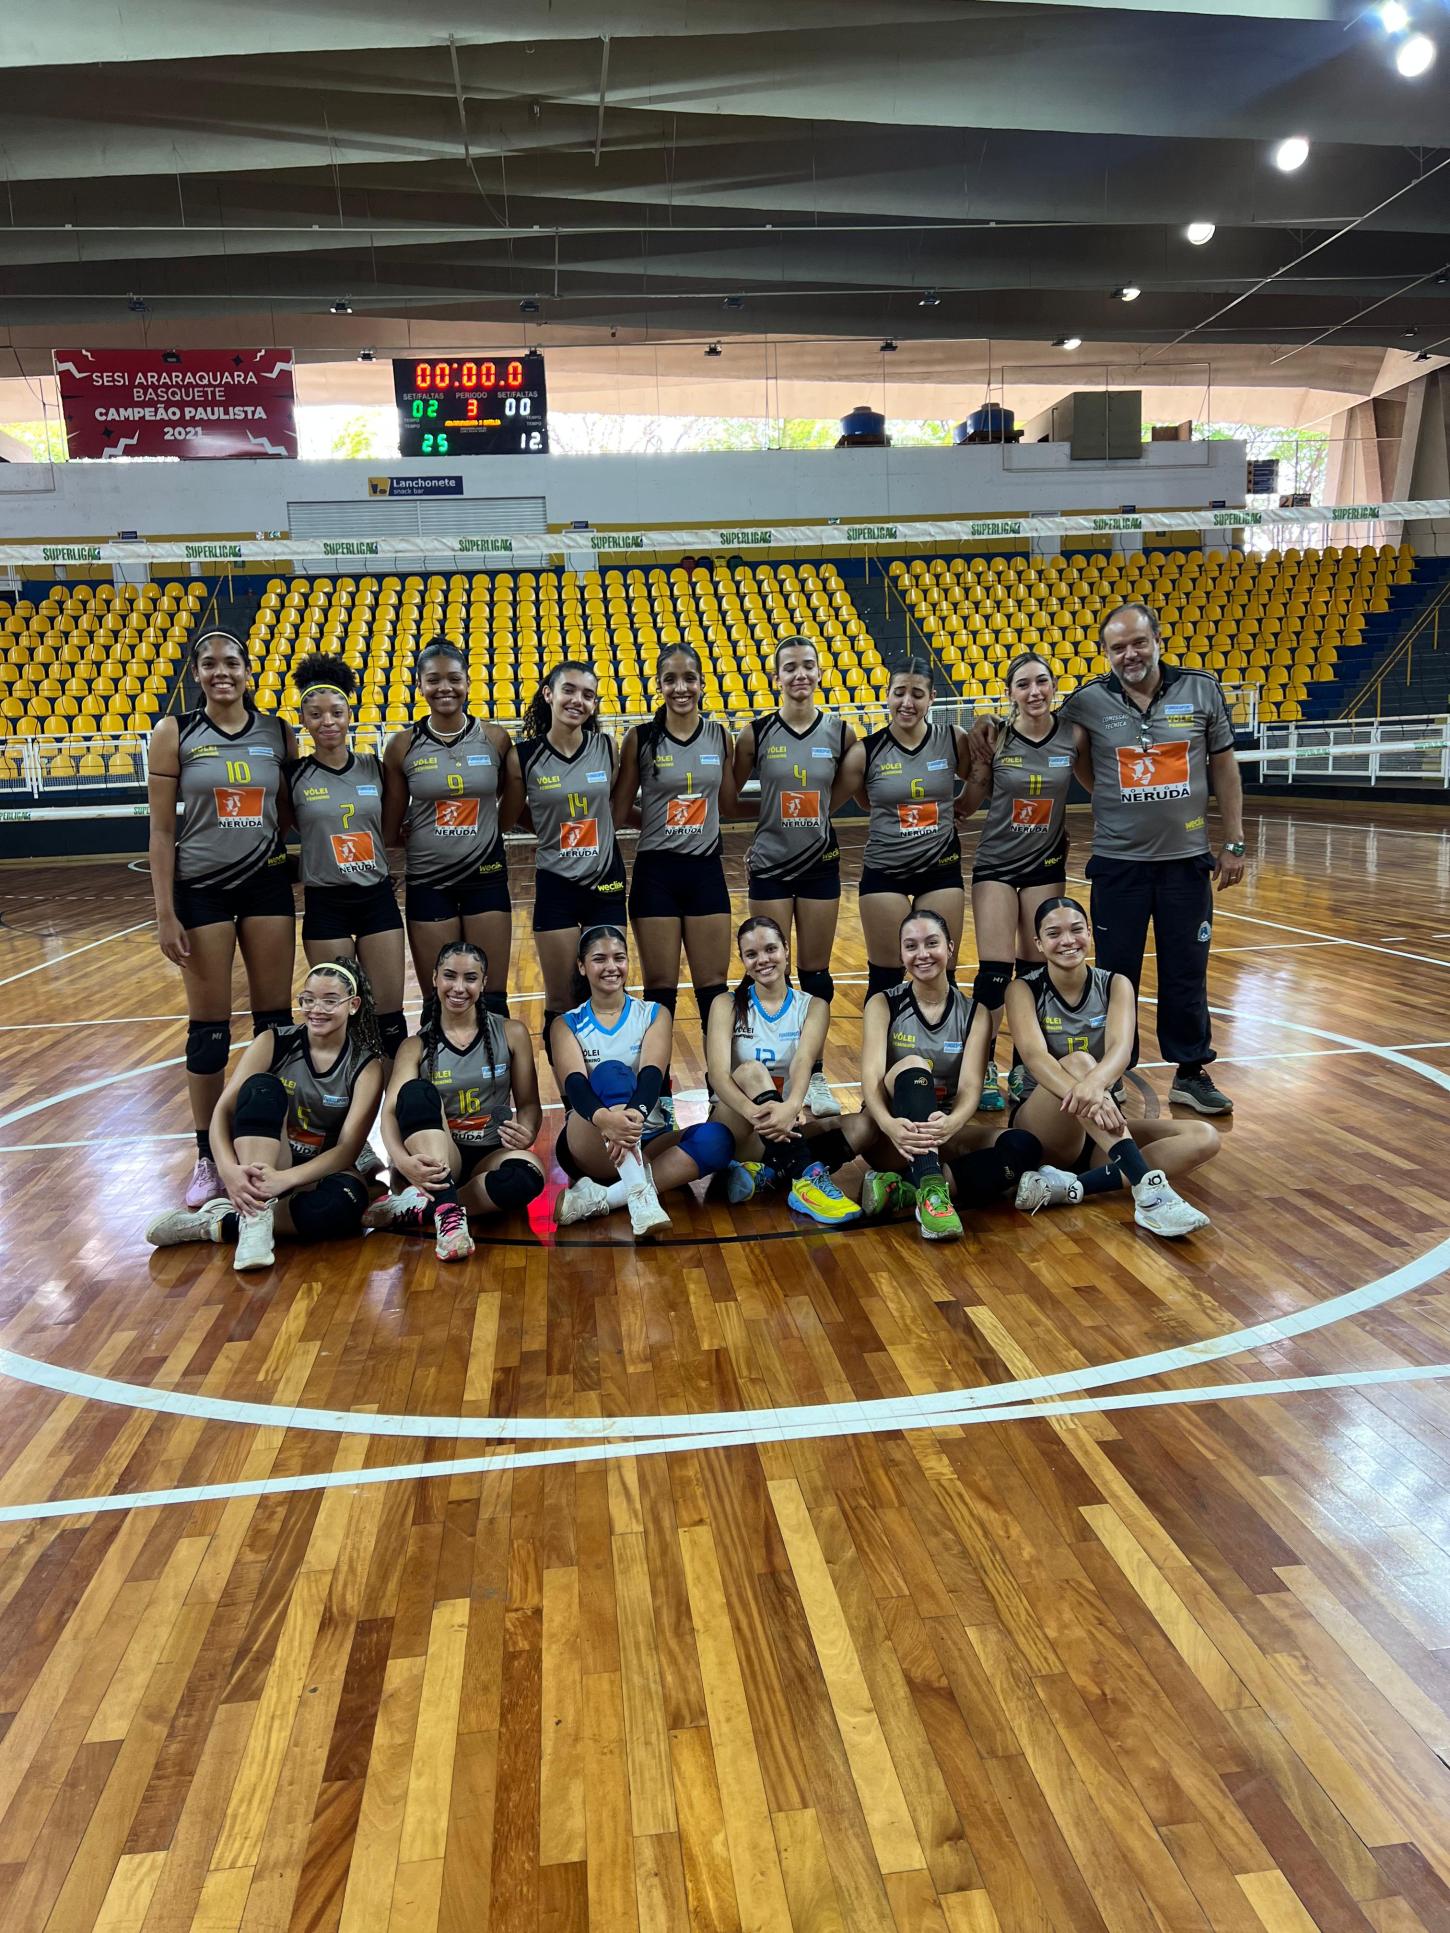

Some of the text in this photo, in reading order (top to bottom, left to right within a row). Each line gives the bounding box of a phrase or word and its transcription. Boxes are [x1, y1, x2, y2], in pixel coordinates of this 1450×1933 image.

[92, 371, 258, 386] SESI ARARAQUARA
[133, 387, 226, 401] BASQUETE
[94, 403, 267, 421] CAMPEÃO PAULISTA
[412, 399, 439, 418] 02
[467, 398, 478, 416] 3
[504, 397, 531, 416] 00
[163, 426, 203, 441] 2021
[421, 433, 449, 453] 25
[393, 478, 456, 488] Lanchonete
[1213, 513, 1258, 526] SUPERLIGA
[1331, 506, 1376, 520] SUPERLIGA
[846, 526, 892, 540] SUPERLIGA
[970, 522, 1015, 536] SUPERLIGA
[590, 535, 639, 549] SUPERLIGA
[719, 531, 767, 545] SUPERLIGA
[185, 544, 234, 559] SUPERLIGA
[323, 541, 372, 556] SUPERLIGA
[458, 538, 507, 553] SUPERLIGA
[42, 547, 94, 562] SUPERLIGA
[655, 754, 673, 763] ÔLEI
[225, 760, 252, 785] 10
[793, 764, 807, 787] 4
[447, 773, 464, 796] 9
[685, 771, 693, 795] 1
[910, 778, 925, 800] 6
[1029, 774, 1042, 796] 11
[1121, 788, 1190, 802] NERUDA
[567, 792, 589, 818] 14
[339, 803, 355, 829] 7
[218, 820, 263, 828] NERUDA
[664, 826, 703, 835] NERUDA
[781, 820, 820, 828] NERUDA
[1010, 823, 1049, 833] NERUDA
[434, 828, 478, 836] NERUDA
[900, 828, 938, 838] NERUDA
[559, 848, 599, 857] NERUDA
[339, 863, 376, 873] NERUDA
[1045, 1016, 1062, 1024] ÔLEI
[583, 1048, 600, 1057] ÔLEI
[755, 1047, 776, 1071] 12
[458, 1087, 481, 1114] 16
[452, 1133, 482, 1141] RUDA
